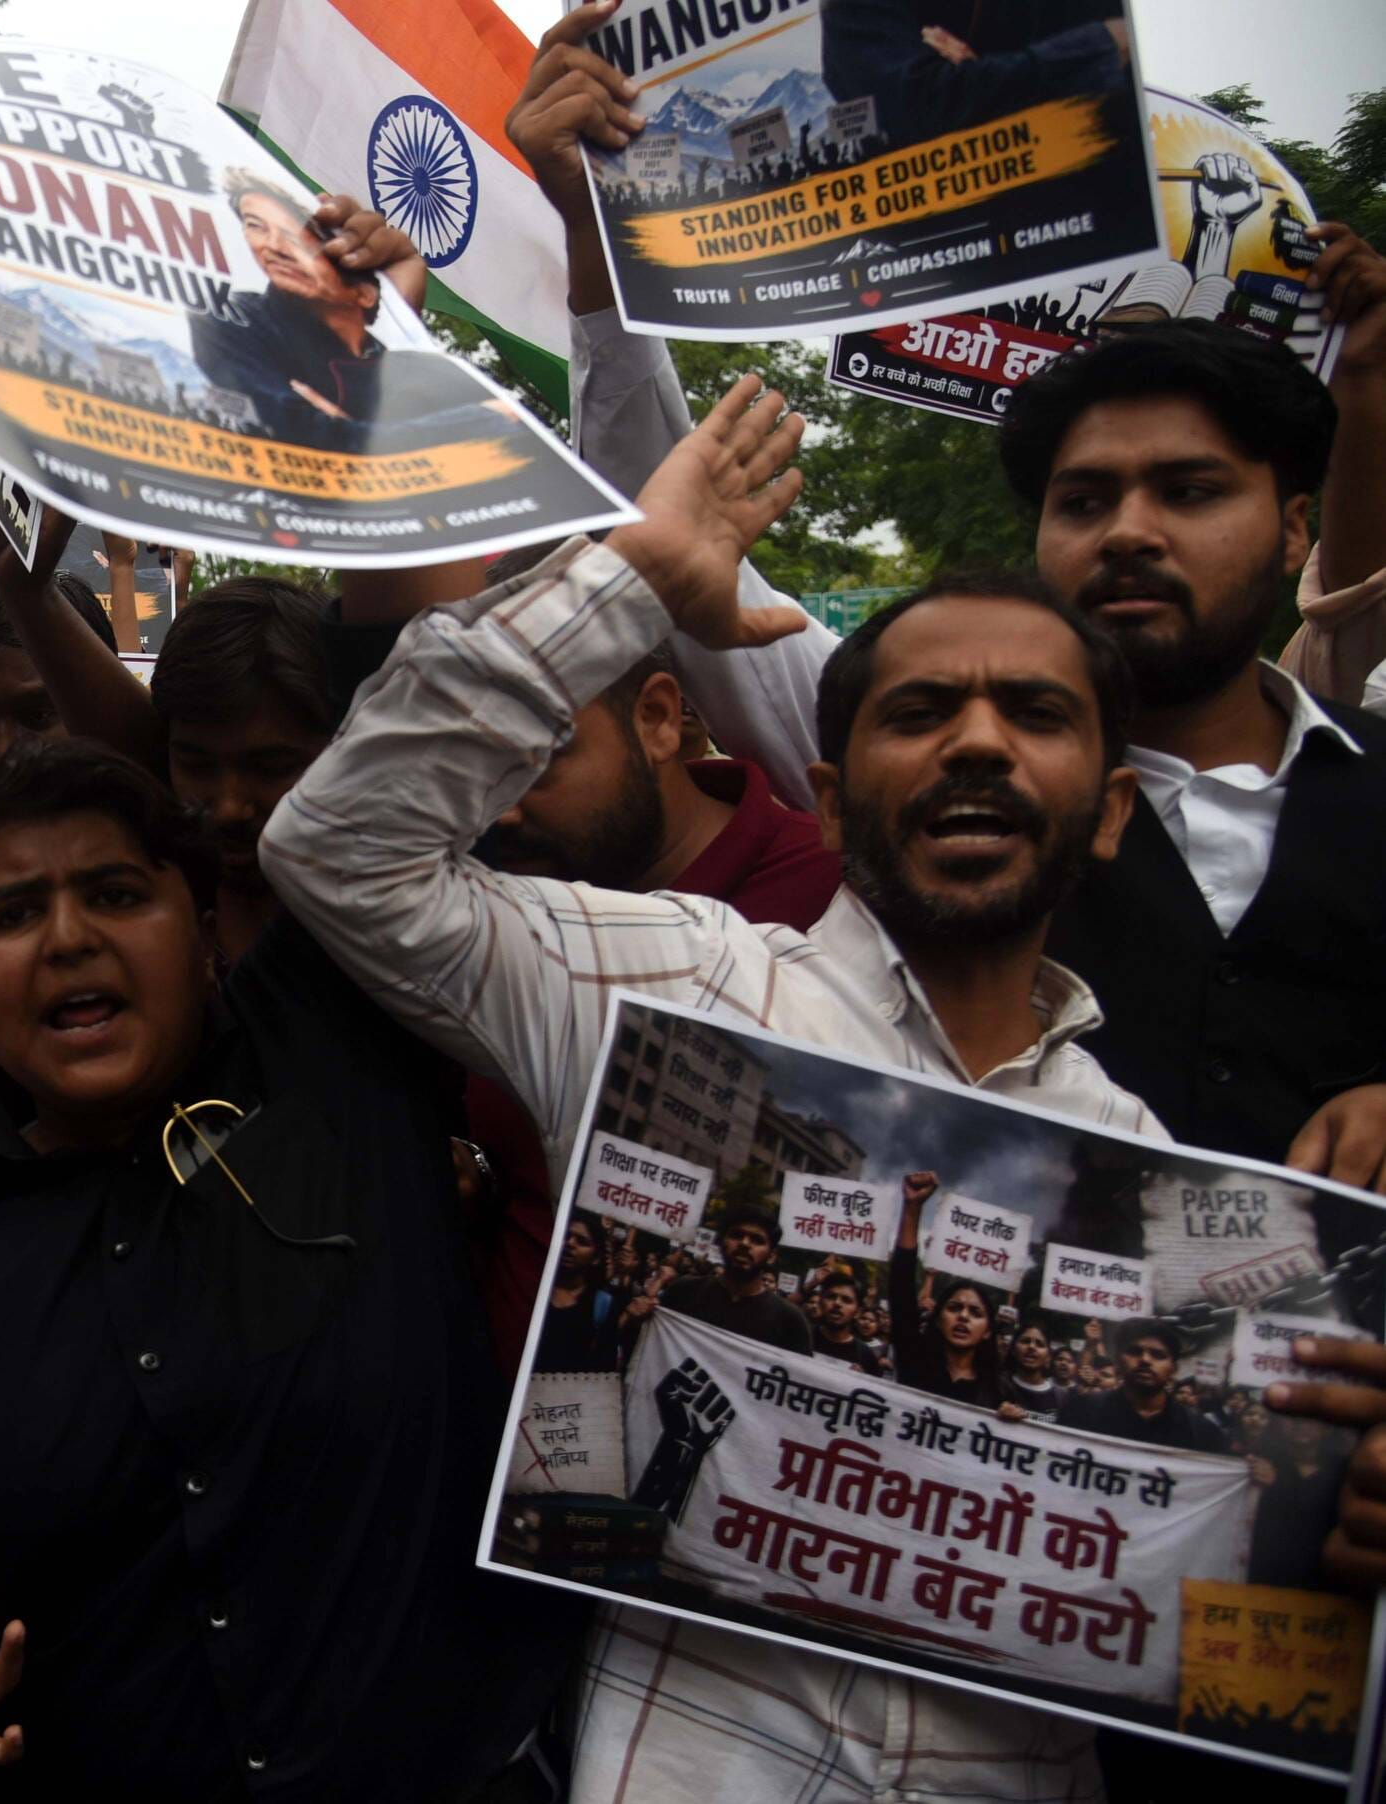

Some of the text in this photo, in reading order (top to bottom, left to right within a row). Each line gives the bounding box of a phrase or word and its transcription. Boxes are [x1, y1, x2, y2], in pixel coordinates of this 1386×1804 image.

[680, 120, 1041, 238] STANDING FOR EDUCATION,
[696, 151, 1037, 260] INNOVATION & OUR FUTURE
[673, 212, 1094, 305] TRUTH COURAGE COMPASSION CHANGE
[901, 320, 1000, 370] आओ
[872, 364, 886, 379] हर
[907, 371, 921, 388] को
[42, 390, 257, 459] STANDING FOR
[65, 417, 233, 472] INNOVATION
[271, 469, 327, 491] OUR
[337, 472, 445, 493] FUTURE
[34, 450, 540, 537] TRUTH COURAGE COMPASSION CHANGE
[639, 1159, 659, 1182] पर
[660, 1168, 700, 1195] हमला
[1182, 1189, 1268, 1212] PAPER
[654, 1201, 689, 1227] नहीं
[794, 1214, 876, 1245] नहीं चलेगी
[950, 1206, 1017, 1241] पेपर लीक
[1185, 1215, 1267, 1238] LEAK
[945, 1235, 1010, 1272] बंद करो
[969, 1422, 1040, 1476] पेपर
[1046, 1448, 1132, 1497] लीक
[1139, 1467, 1175, 1508] से
[772, 1438, 1128, 1580] प्रतिभाओं को
[713, 1494, 1156, 1666] मारना बंद करो
